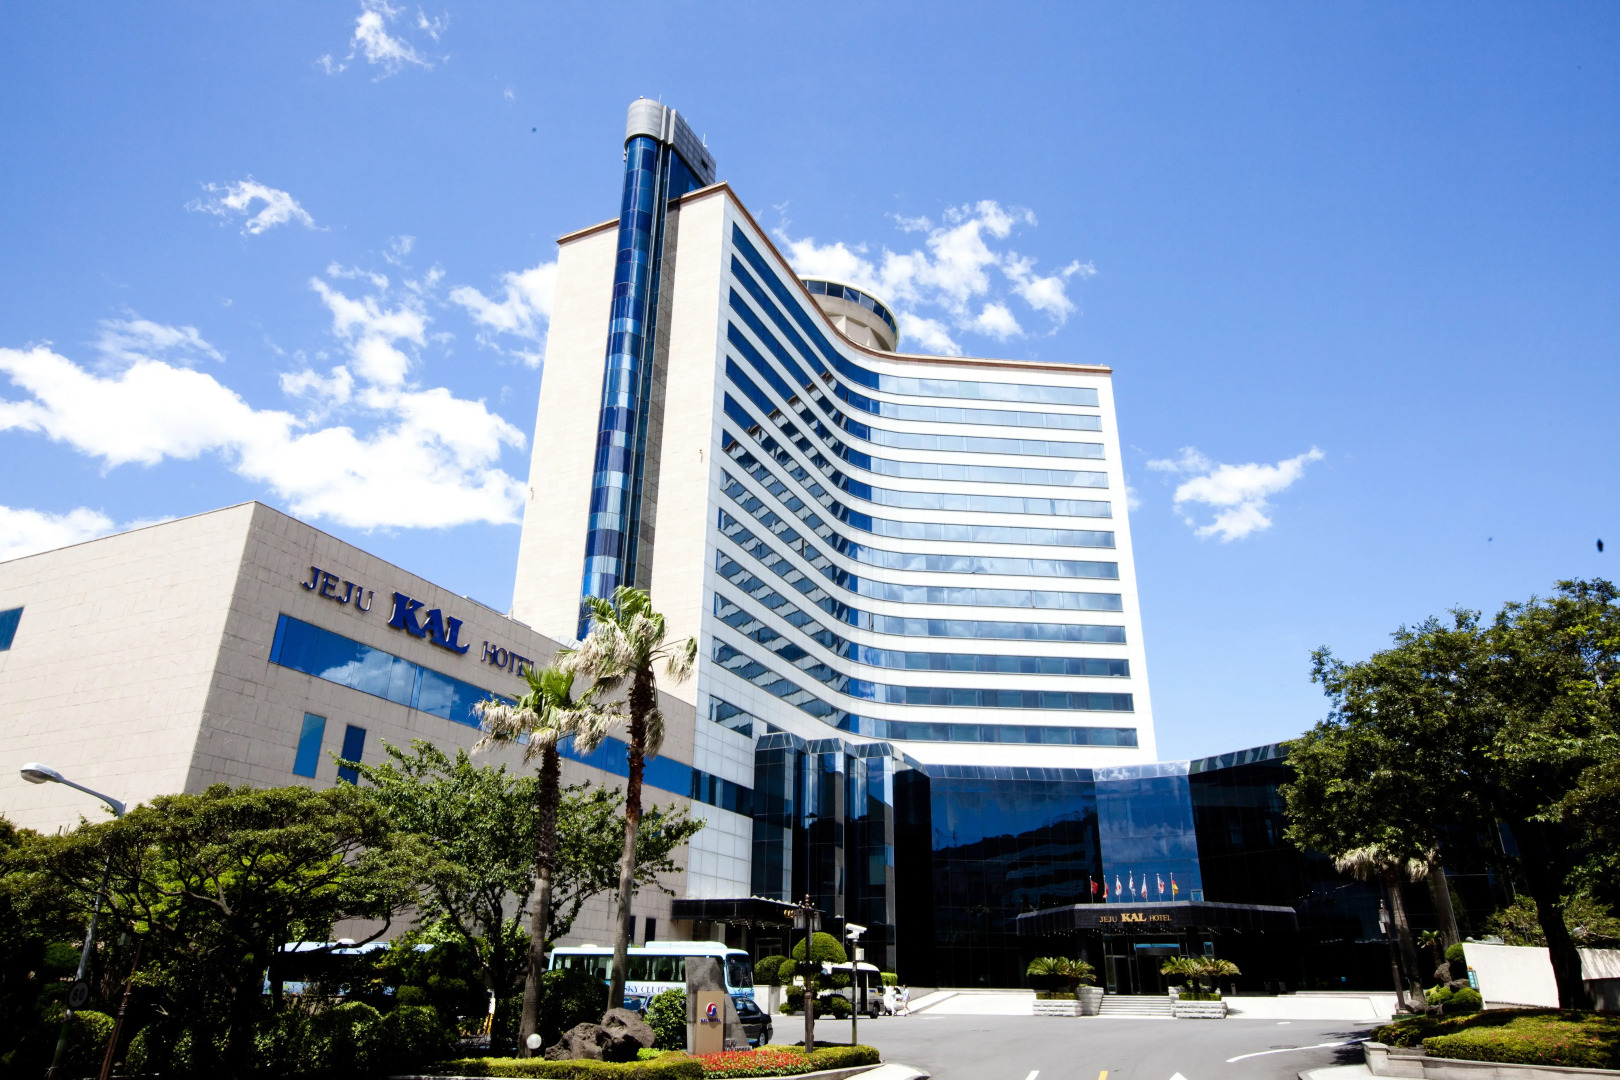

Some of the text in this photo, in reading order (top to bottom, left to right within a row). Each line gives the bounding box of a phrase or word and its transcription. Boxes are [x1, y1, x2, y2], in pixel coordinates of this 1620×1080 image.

[302, 565, 375, 611] JEJU
[388, 591, 470, 655] KAL
[1099, 912, 1172, 923] JEJU KAL HOTEL
